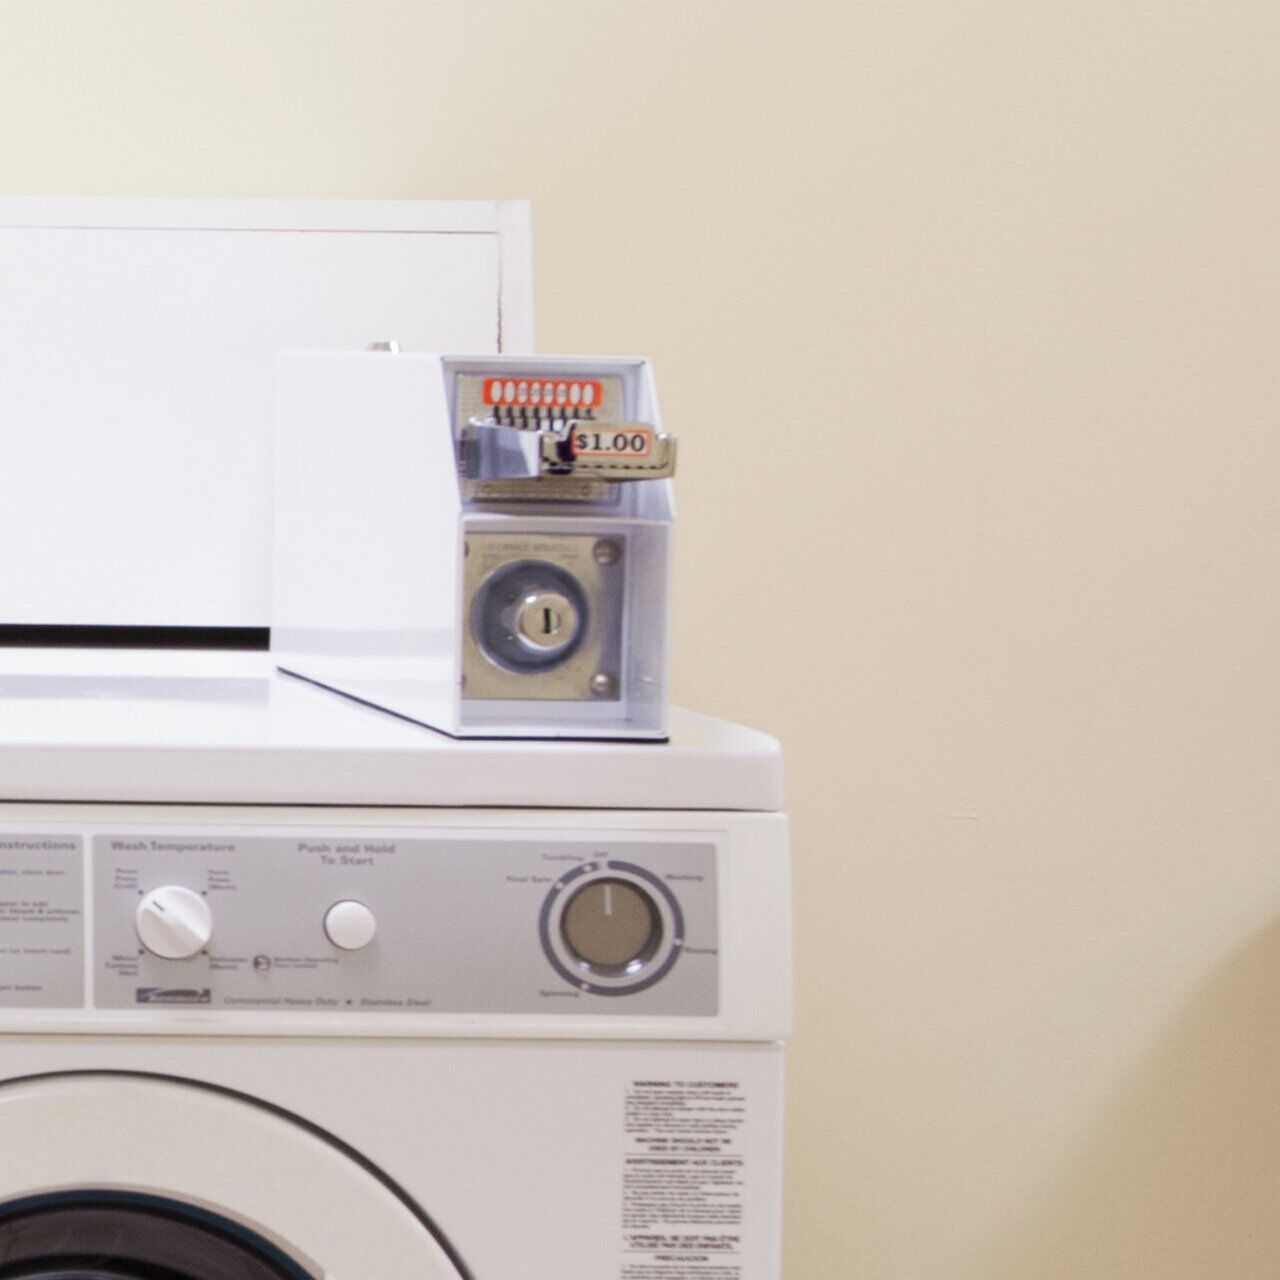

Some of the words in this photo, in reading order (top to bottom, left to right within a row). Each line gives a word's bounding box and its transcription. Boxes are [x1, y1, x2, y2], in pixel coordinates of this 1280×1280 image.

[576, 433, 646, 452] $1.00
[111, 841, 147, 851] Wash
[150, 841, 235, 852] Temperature
[298, 843, 331, 853] Push
[335, 844, 360, 853] and
[364, 844, 396, 854] Hold
[321, 855, 336, 865] To
[340, 855, 374, 865] Start
